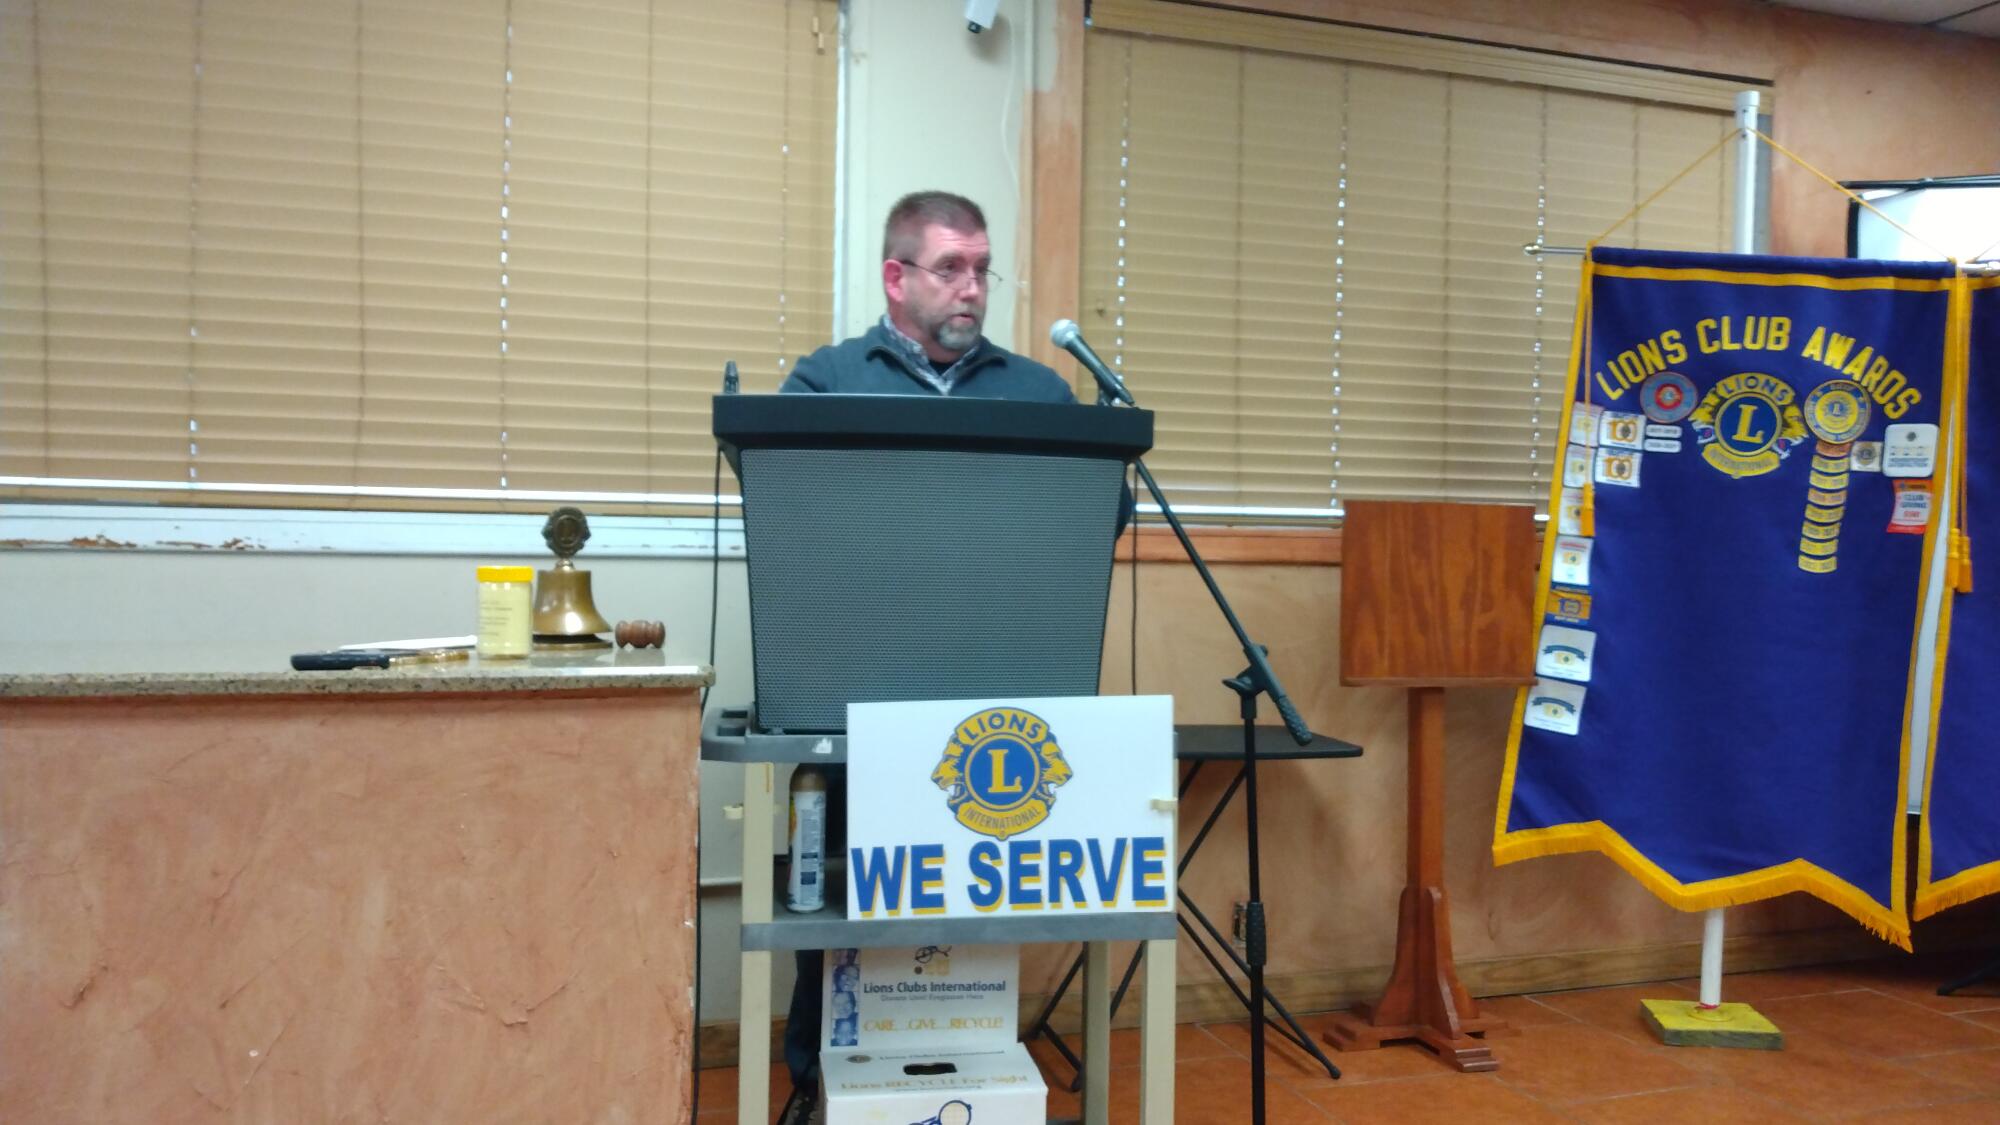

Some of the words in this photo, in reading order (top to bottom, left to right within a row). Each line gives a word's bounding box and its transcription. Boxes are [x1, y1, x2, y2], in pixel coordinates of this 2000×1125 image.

[1595, 329, 1689, 401] LIONS
[1695, 315, 1792, 354] CLUB
[1801, 326, 1922, 419] AWARDS
[1722, 375, 1790, 404] LIONS
[1731, 404, 1765, 443] L
[963, 712, 1042, 740] LIONS
[988, 749, 1023, 793] L
[963, 806, 1041, 829] INTERNATIONAL
[850, 844, 946, 918] WE
[967, 836, 1167, 913] SERVE
[864, 983, 893, 993] Lions
[897, 982, 928, 993] Clubs
[931, 980, 1006, 993] International
